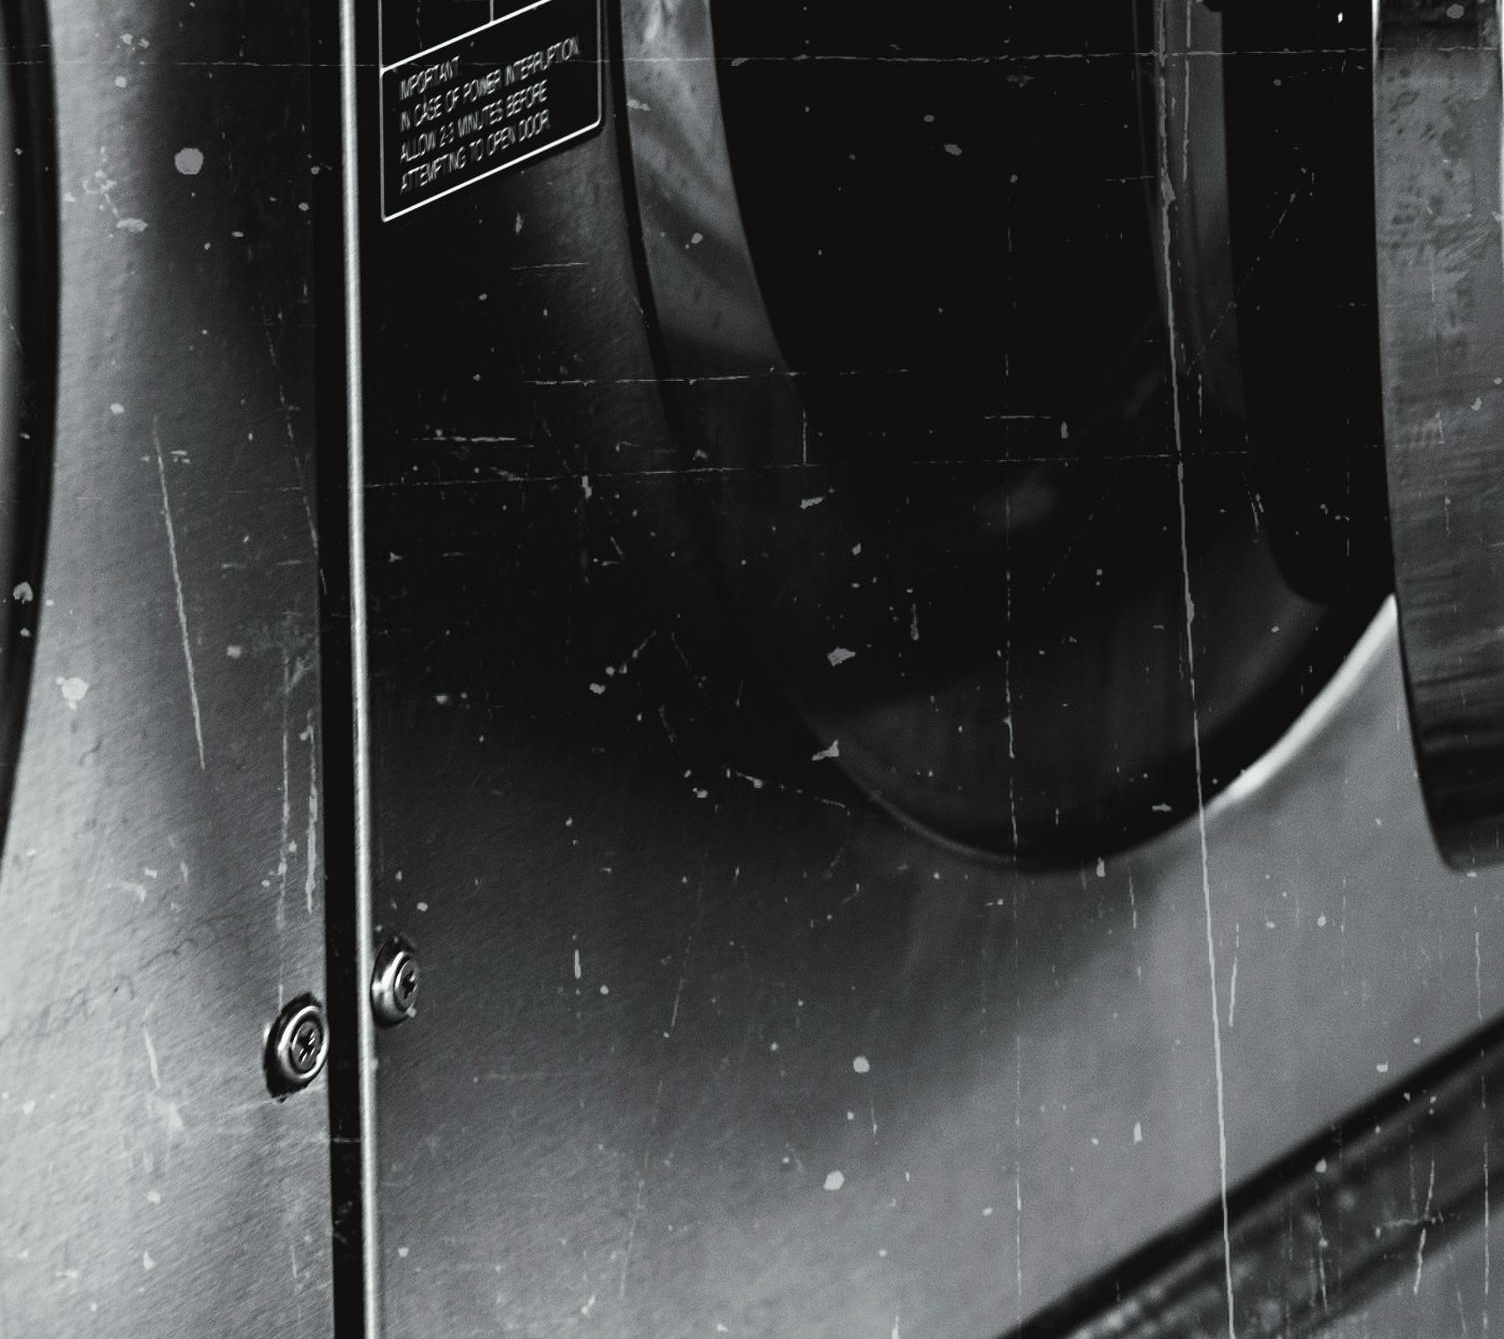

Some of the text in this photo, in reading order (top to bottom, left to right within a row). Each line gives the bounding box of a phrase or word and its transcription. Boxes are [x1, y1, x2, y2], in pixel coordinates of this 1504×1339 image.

[399, 110, 411, 133] IN
[414, 94, 442, 127] CASE
[444, 86, 461, 114] OF
[463, 68, 502, 104] POWER
[399, 129, 437, 164] ALLOW
[457, 98, 504, 139] MINUTES
[505, 79, 548, 118] BEFORE
[399, 146, 467, 195] ATTEMPTING
[468, 137, 484, 163] TO
[485, 126, 516, 157] OPEN
